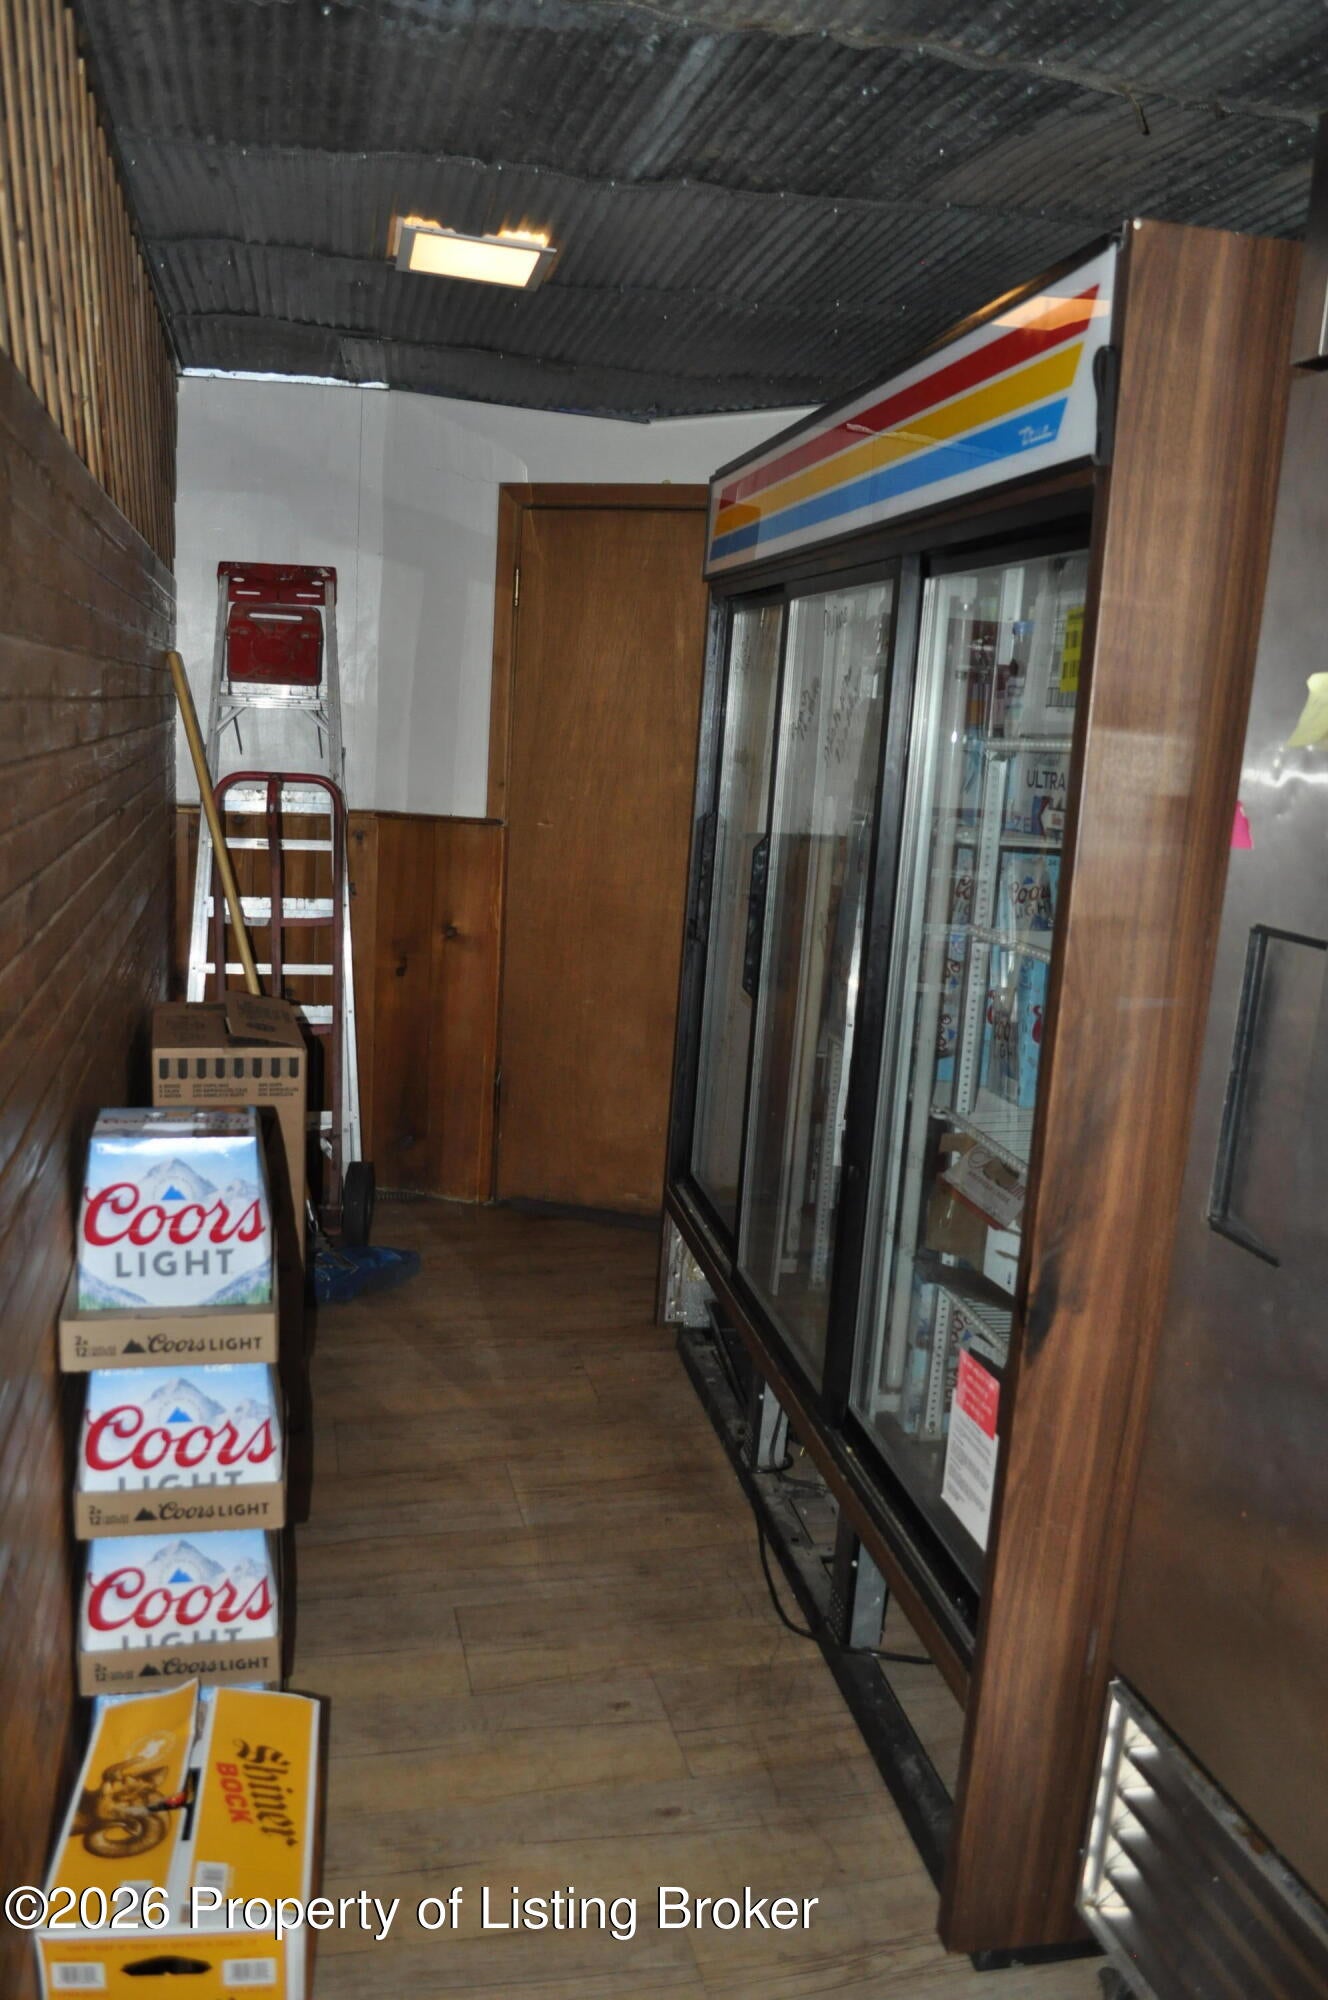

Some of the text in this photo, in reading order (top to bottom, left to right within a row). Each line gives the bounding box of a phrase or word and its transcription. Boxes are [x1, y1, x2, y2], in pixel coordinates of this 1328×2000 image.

[1026, 768, 1066, 791] ULTRA
[82, 1182, 266, 1247] Coors
[115, 1247, 235, 1279] LIGHT
[147, 1333, 263, 1354] Coors LIGHT
[84, 1404, 277, 1473] Coors
[157, 1501, 270, 1522] Coors LIGHT
[87, 1566, 274, 1632] Coors
[161, 1656, 270, 1676] Coors LIGHT
[216, 1761, 254, 1825] BOCK
[233, 1738, 299, 1848] Shiner
